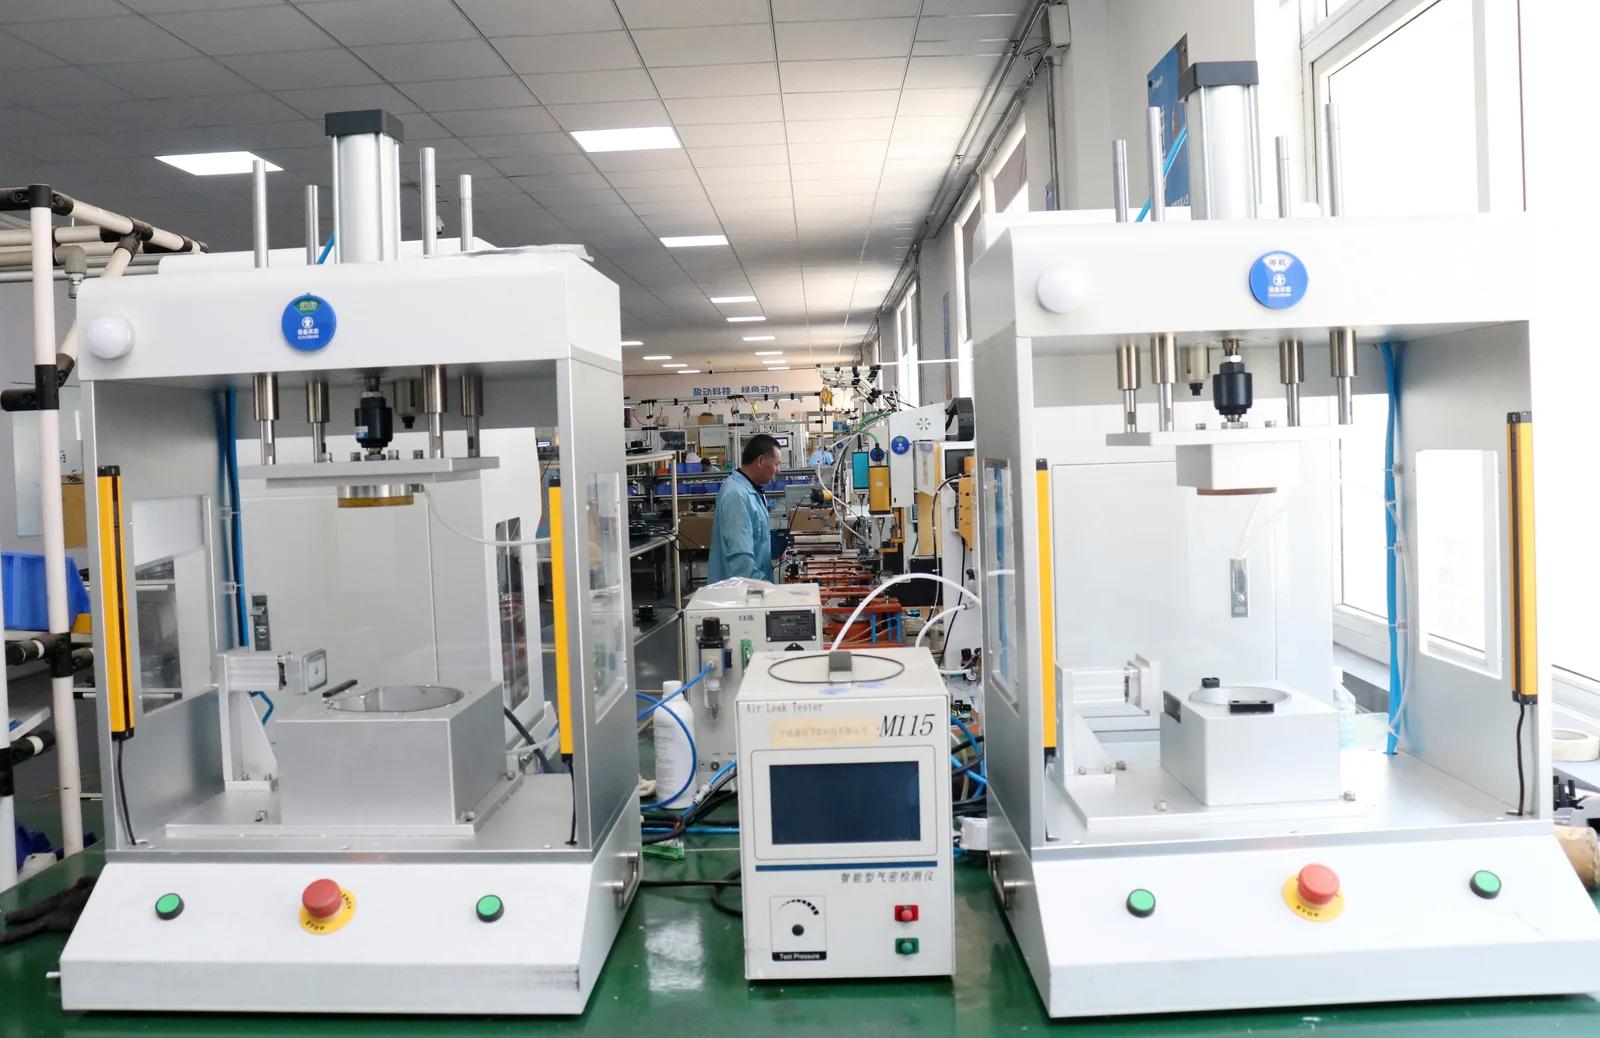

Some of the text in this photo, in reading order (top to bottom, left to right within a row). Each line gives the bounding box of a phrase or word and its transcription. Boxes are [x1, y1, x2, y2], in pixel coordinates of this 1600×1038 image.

[746, 701, 824, 714] Air Leak Tester
[879, 714, 936, 737] M115
[841, 871, 934, 883] 智能型气密检测仪
[1295, 904, 1320, 918] STOP
[304, 920, 326, 932] STOP
[793, 952, 820, 960] Pressure
